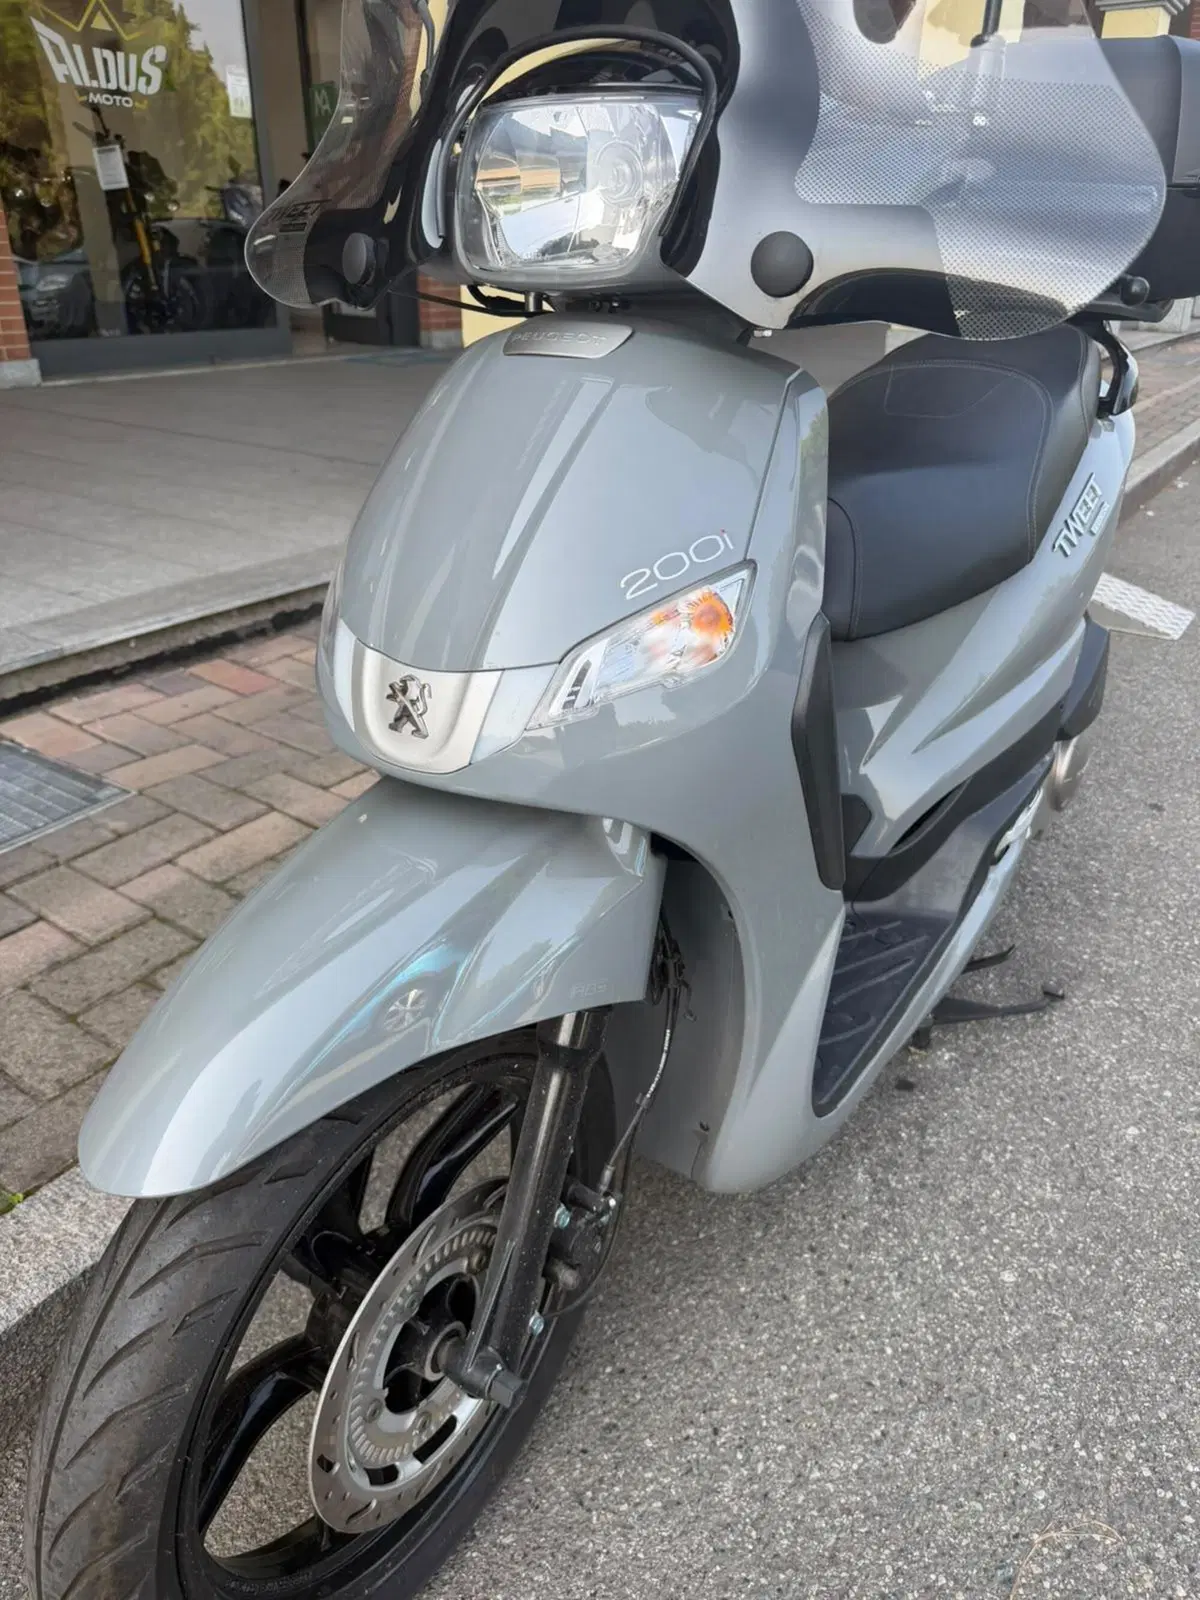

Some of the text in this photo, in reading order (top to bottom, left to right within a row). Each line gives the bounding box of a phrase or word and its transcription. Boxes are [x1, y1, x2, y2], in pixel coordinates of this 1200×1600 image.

[30, 16, 167, 95] ALDUS
[89, 92, 134, 108] MOTO
[511, 330, 608, 346] PEUGEOT
[1052, 472, 1102, 558] TWEET
